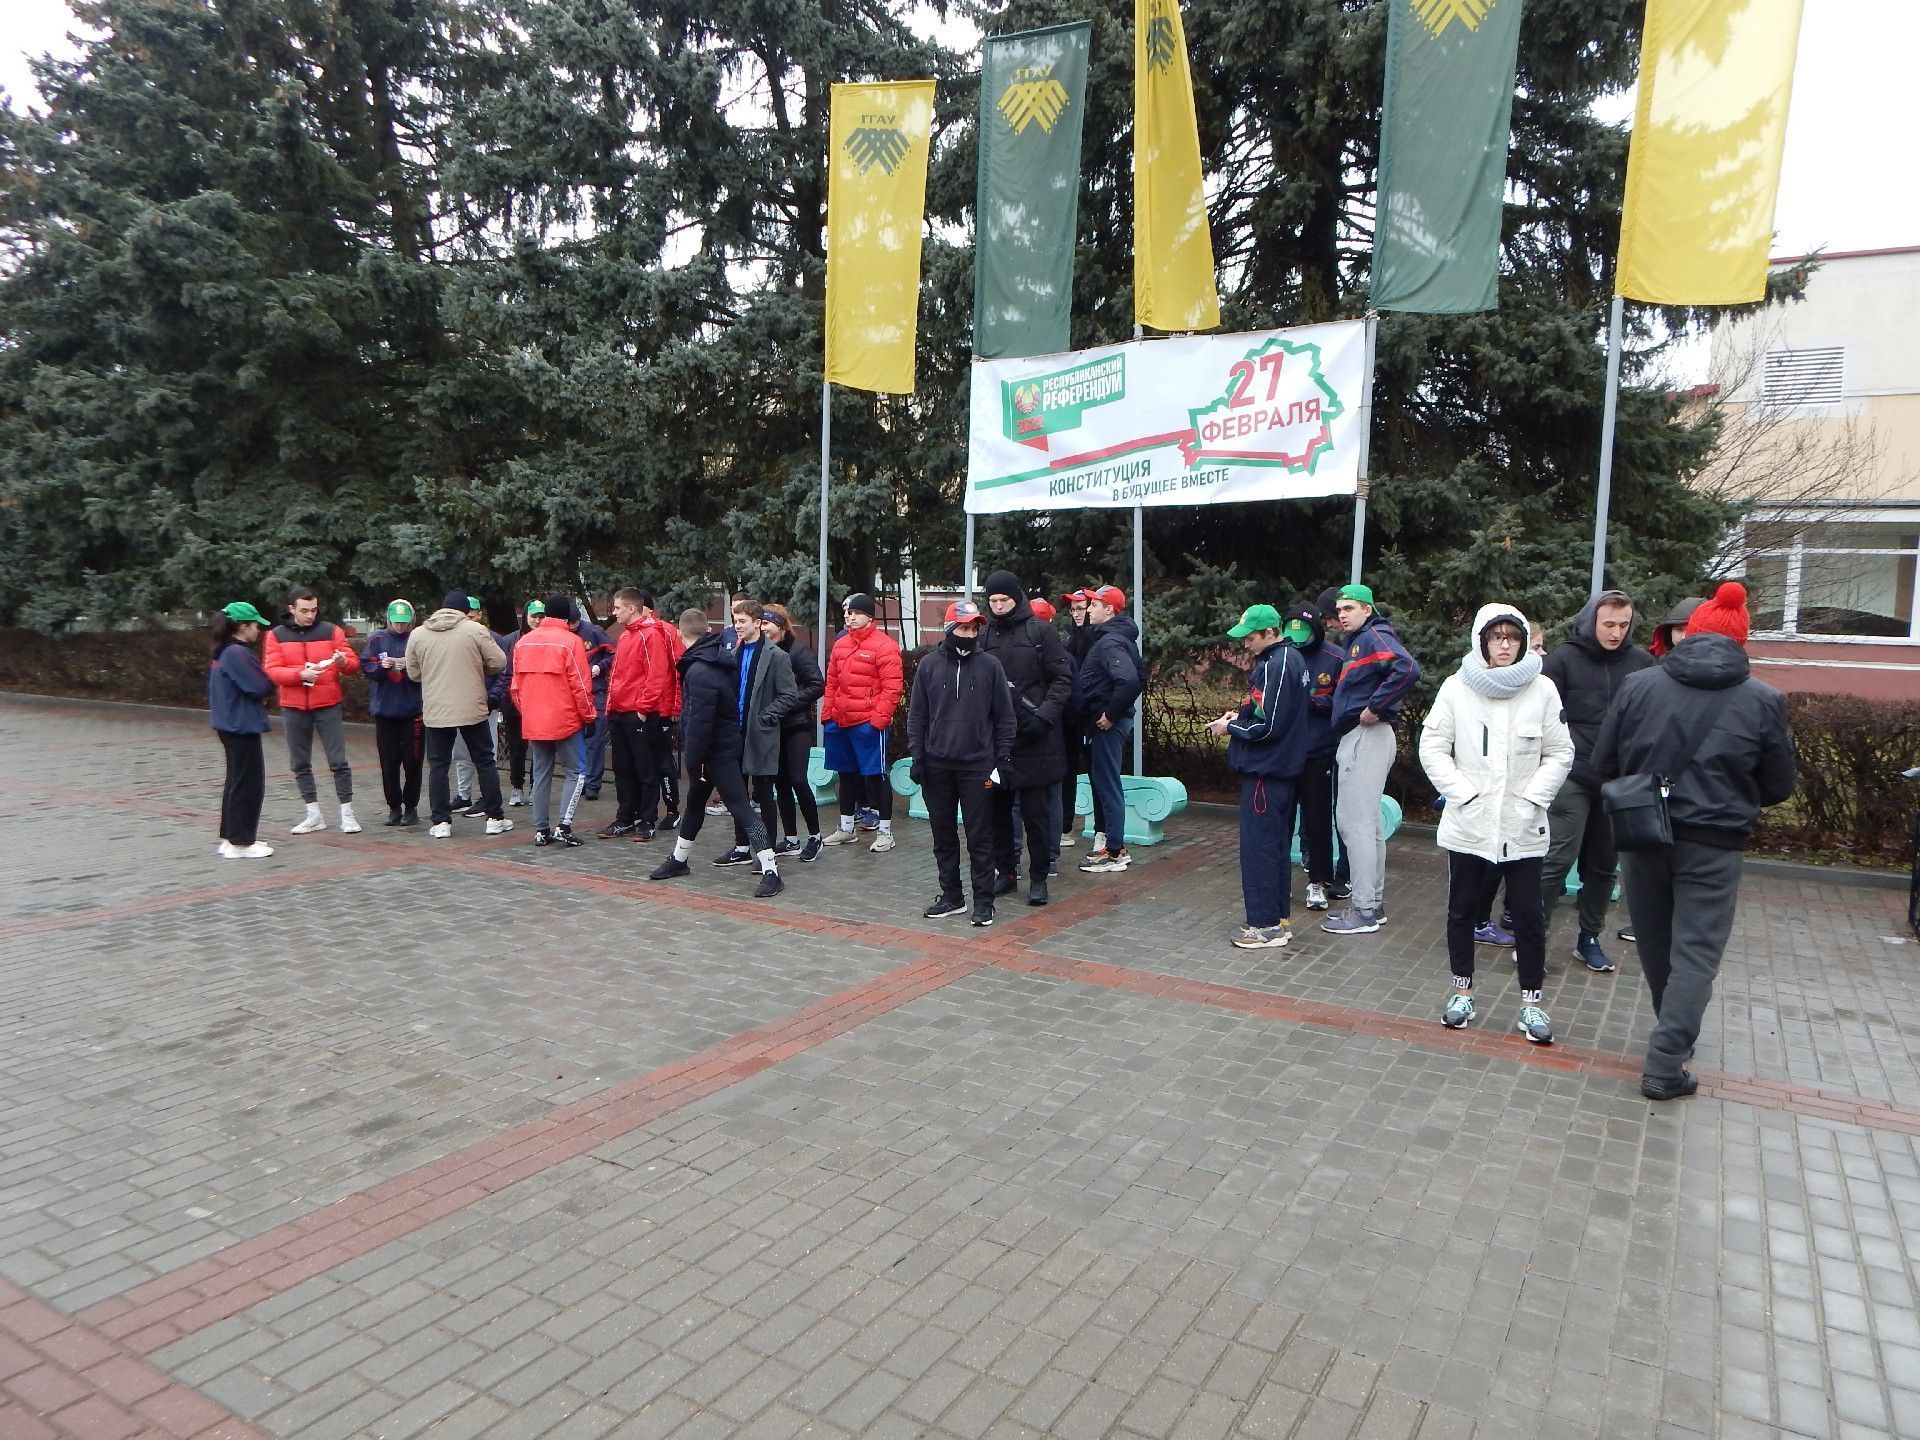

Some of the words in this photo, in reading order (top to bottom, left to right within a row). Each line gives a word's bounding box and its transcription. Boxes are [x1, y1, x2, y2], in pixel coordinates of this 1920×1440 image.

[861, 114, 896, 124] ГГАУ
[1042, 373, 1123, 412] РЕФЕРЕНДУМ
[1043, 356, 1123, 393] РЕСПУБЛИКАНСКИЙ
[1229, 351, 1284, 410] 27
[1201, 397, 1321, 443] ФЕВРАЛЯ
[1049, 459, 1151, 497] КОНСТИТУЦИЯ
[1112, 489, 1119, 501] В
[1122, 478, 1177, 500] БУДУЩЕЕ
[1181, 468, 1229, 489] ВМЕСТЕ
